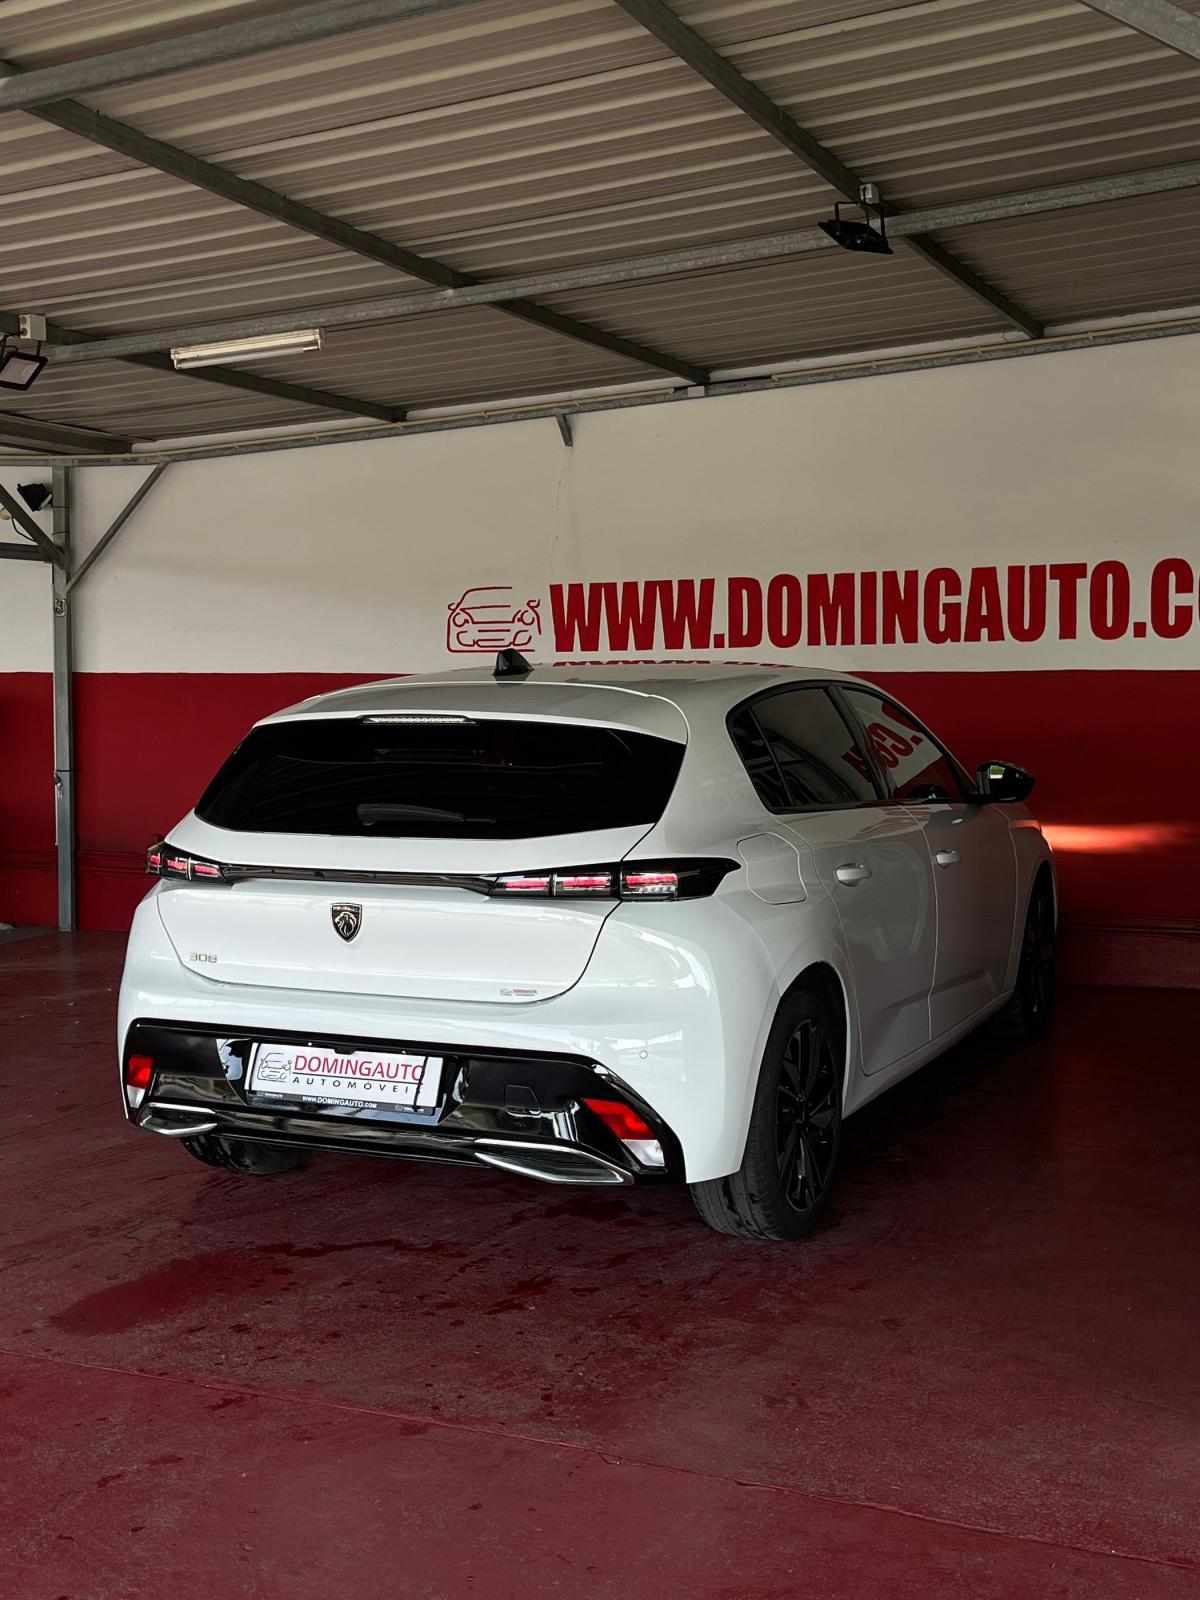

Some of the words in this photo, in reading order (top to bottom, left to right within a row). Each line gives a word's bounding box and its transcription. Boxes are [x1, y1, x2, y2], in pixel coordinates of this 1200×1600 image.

[549, 557, 1200, 653] WWW.DOMINGAUTO.C
[294, 1054, 425, 1082] DOMINGAUTO
[292, 1075, 420, 1096] AUTOMÓVEI
